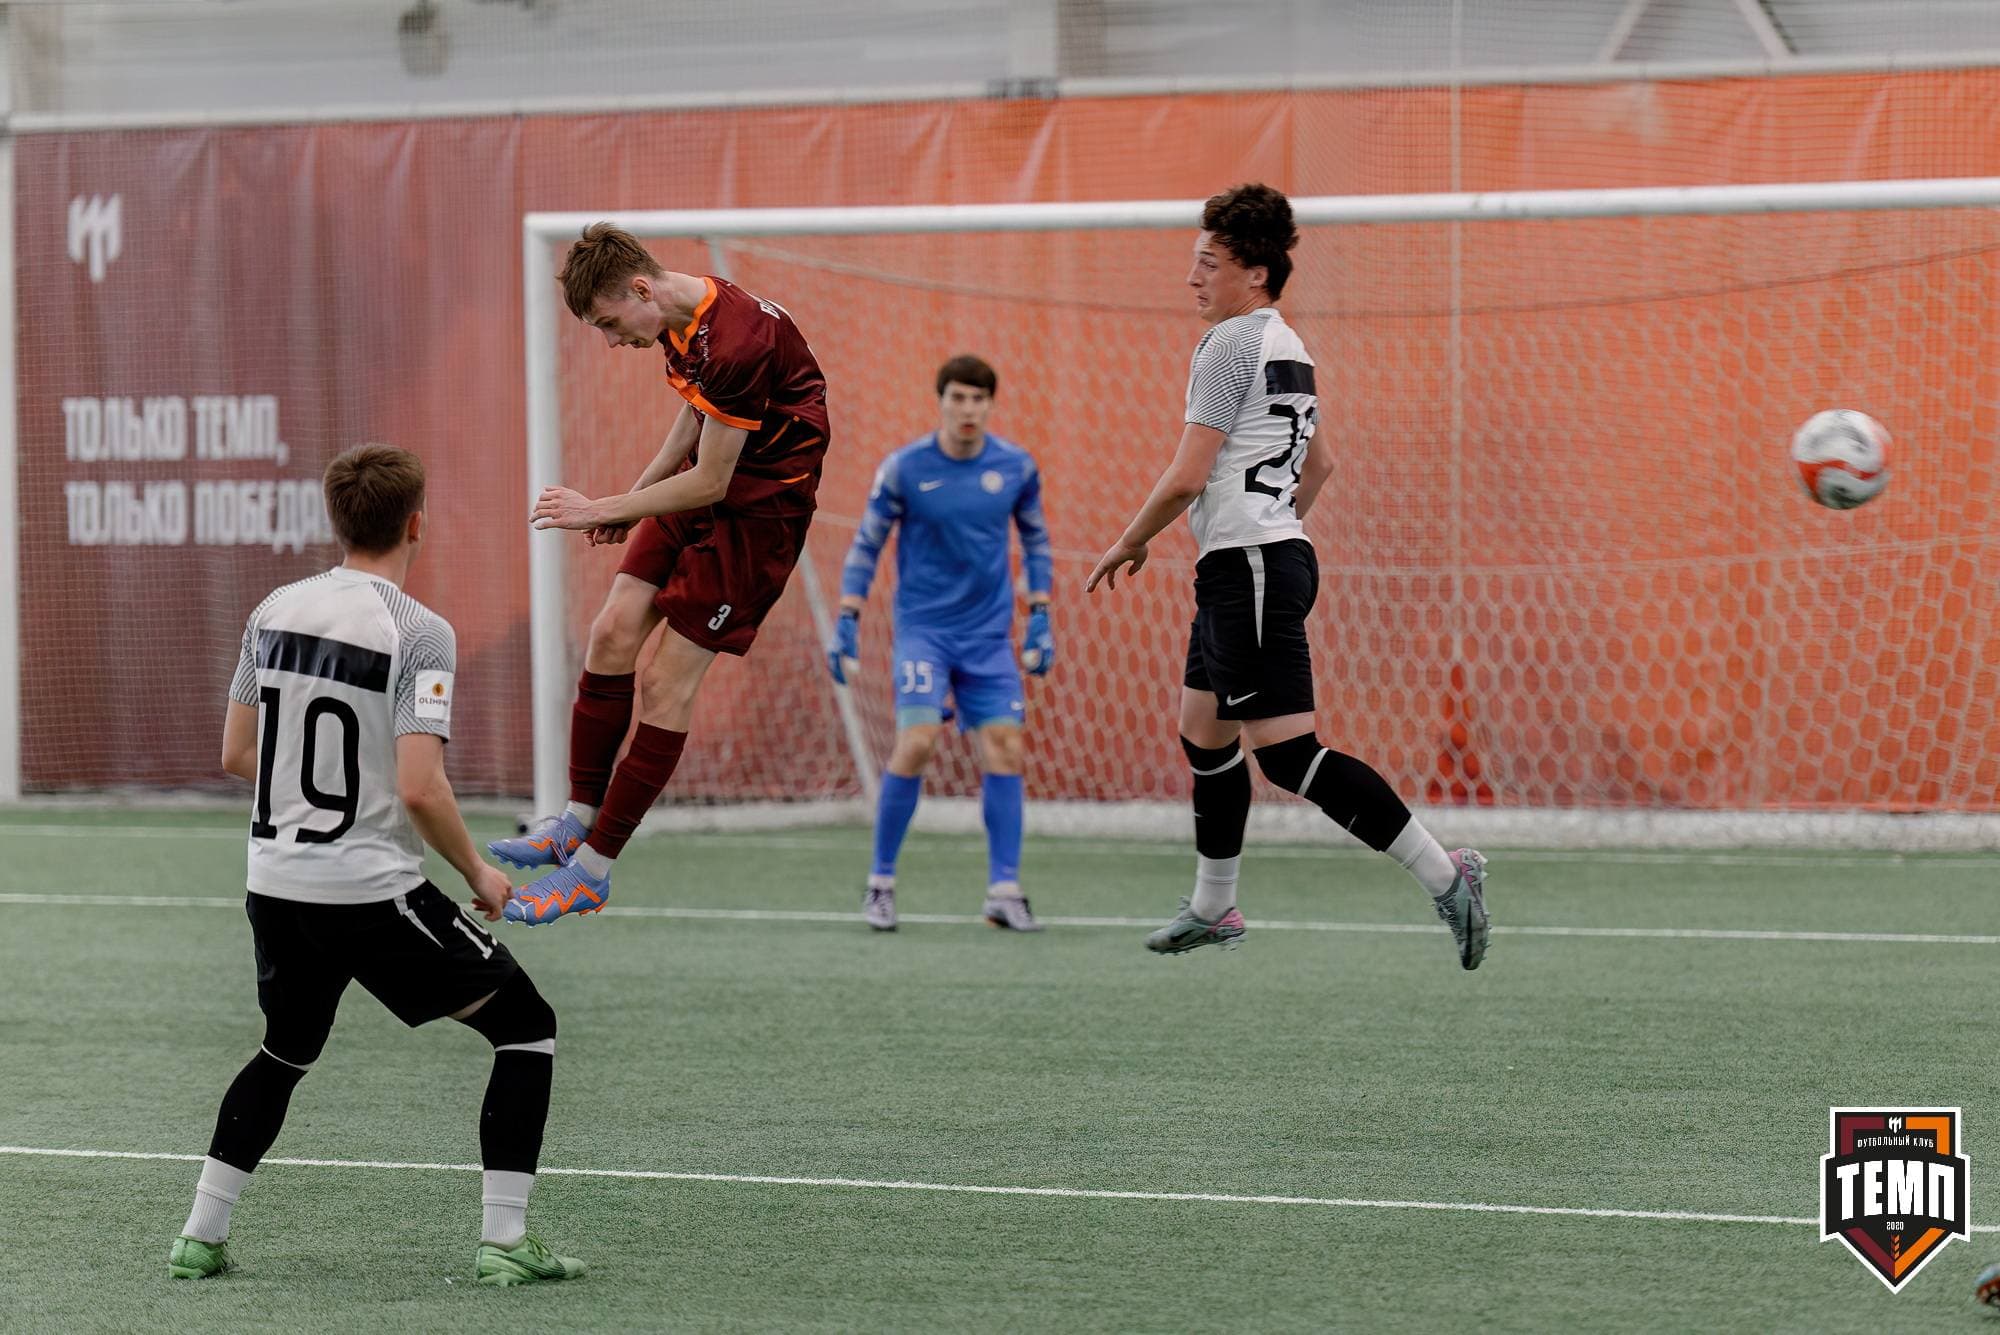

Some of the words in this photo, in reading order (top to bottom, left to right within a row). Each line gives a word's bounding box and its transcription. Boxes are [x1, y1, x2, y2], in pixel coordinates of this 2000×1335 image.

[63, 396, 187, 461] ТОЛЬКО
[192, 395, 289, 466] ТЕМП,
[65, 480, 187, 544] ТОЛЬКО
[707, 604, 732, 631] 3
[900, 660, 933, 694] 35
[251, 686, 360, 844] 19
